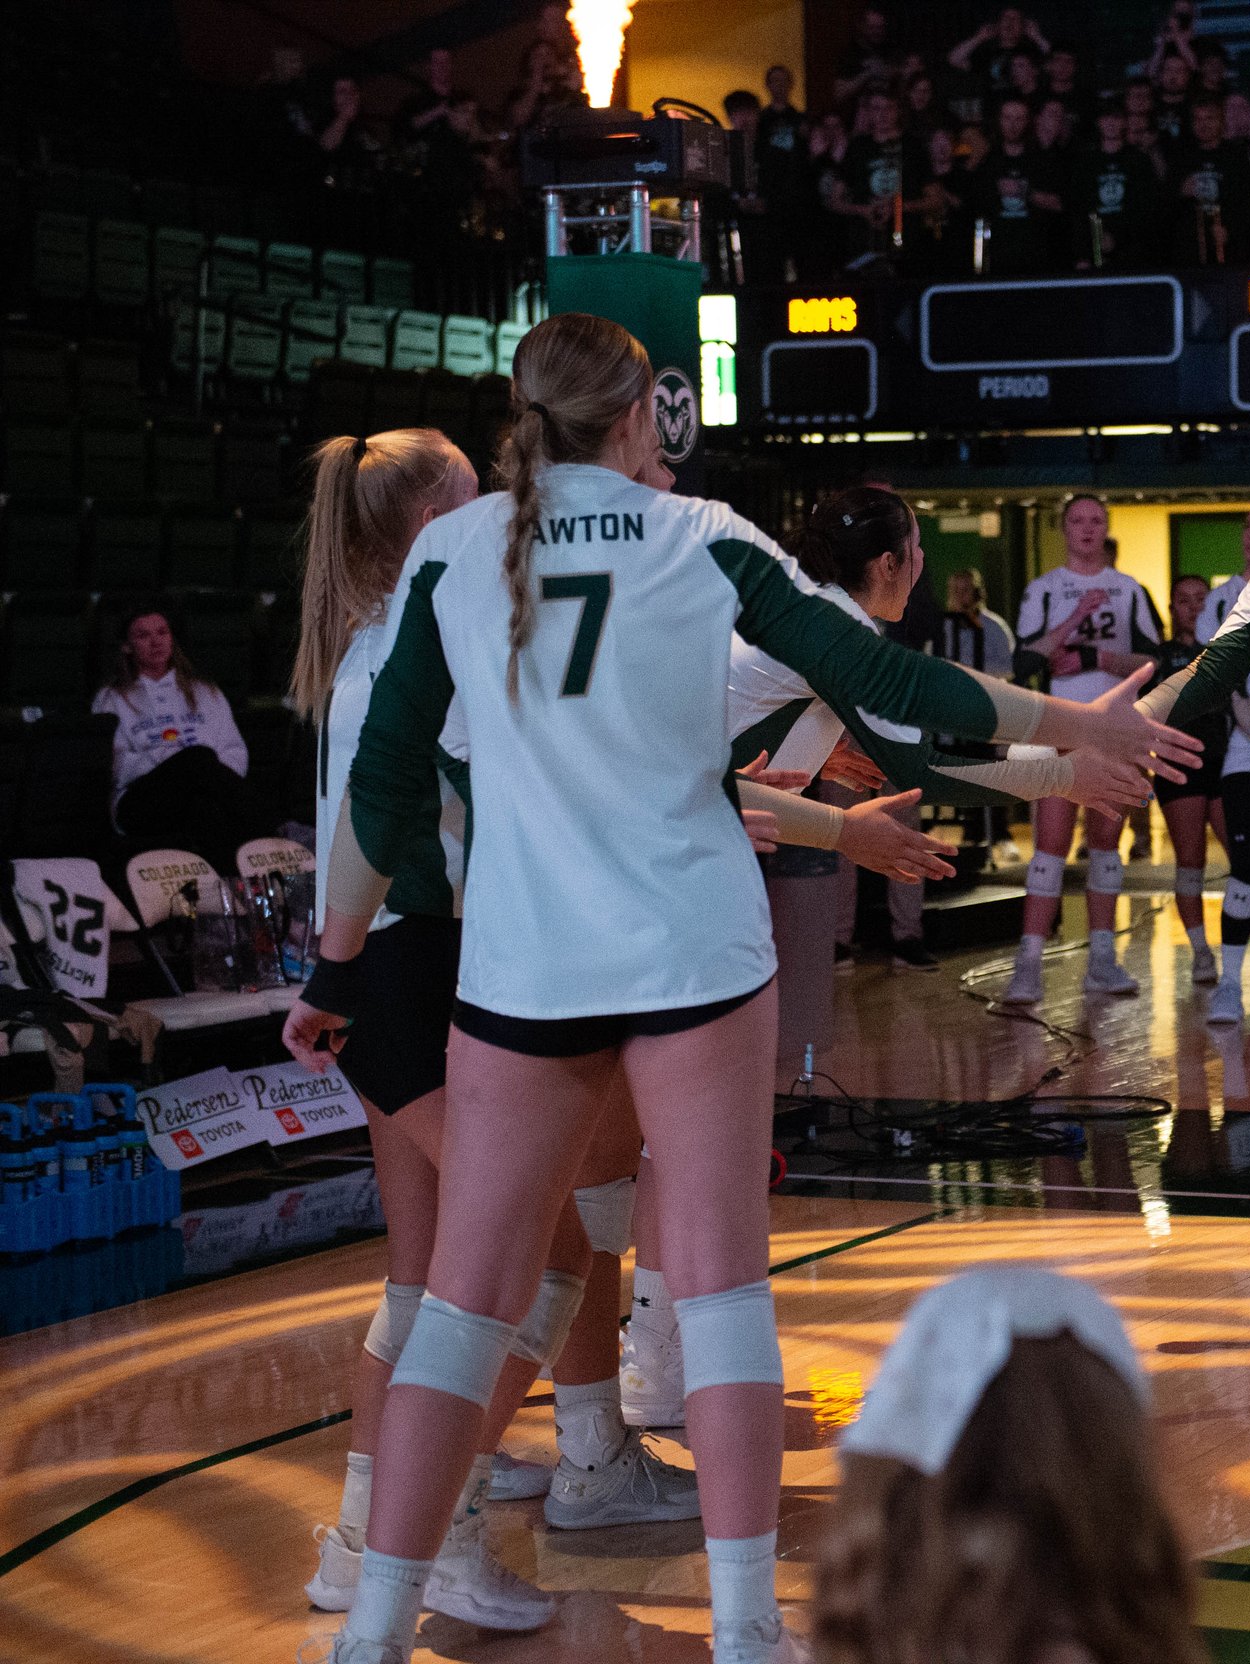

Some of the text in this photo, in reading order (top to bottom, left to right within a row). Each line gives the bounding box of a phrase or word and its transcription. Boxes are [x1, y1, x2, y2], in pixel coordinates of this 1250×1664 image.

[531, 513, 644, 546] AWTON
[538, 570, 616, 699] 7
[1078, 611, 1115, 640] 42
[138, 862, 209, 882] COLORADO
[242, 1074, 344, 1112] Pedersen
[137, 1091, 241, 1136] Pedersen
[300, 1104, 348, 1124] TOYOTA
[197, 1120, 247, 1145] TOYOTA
